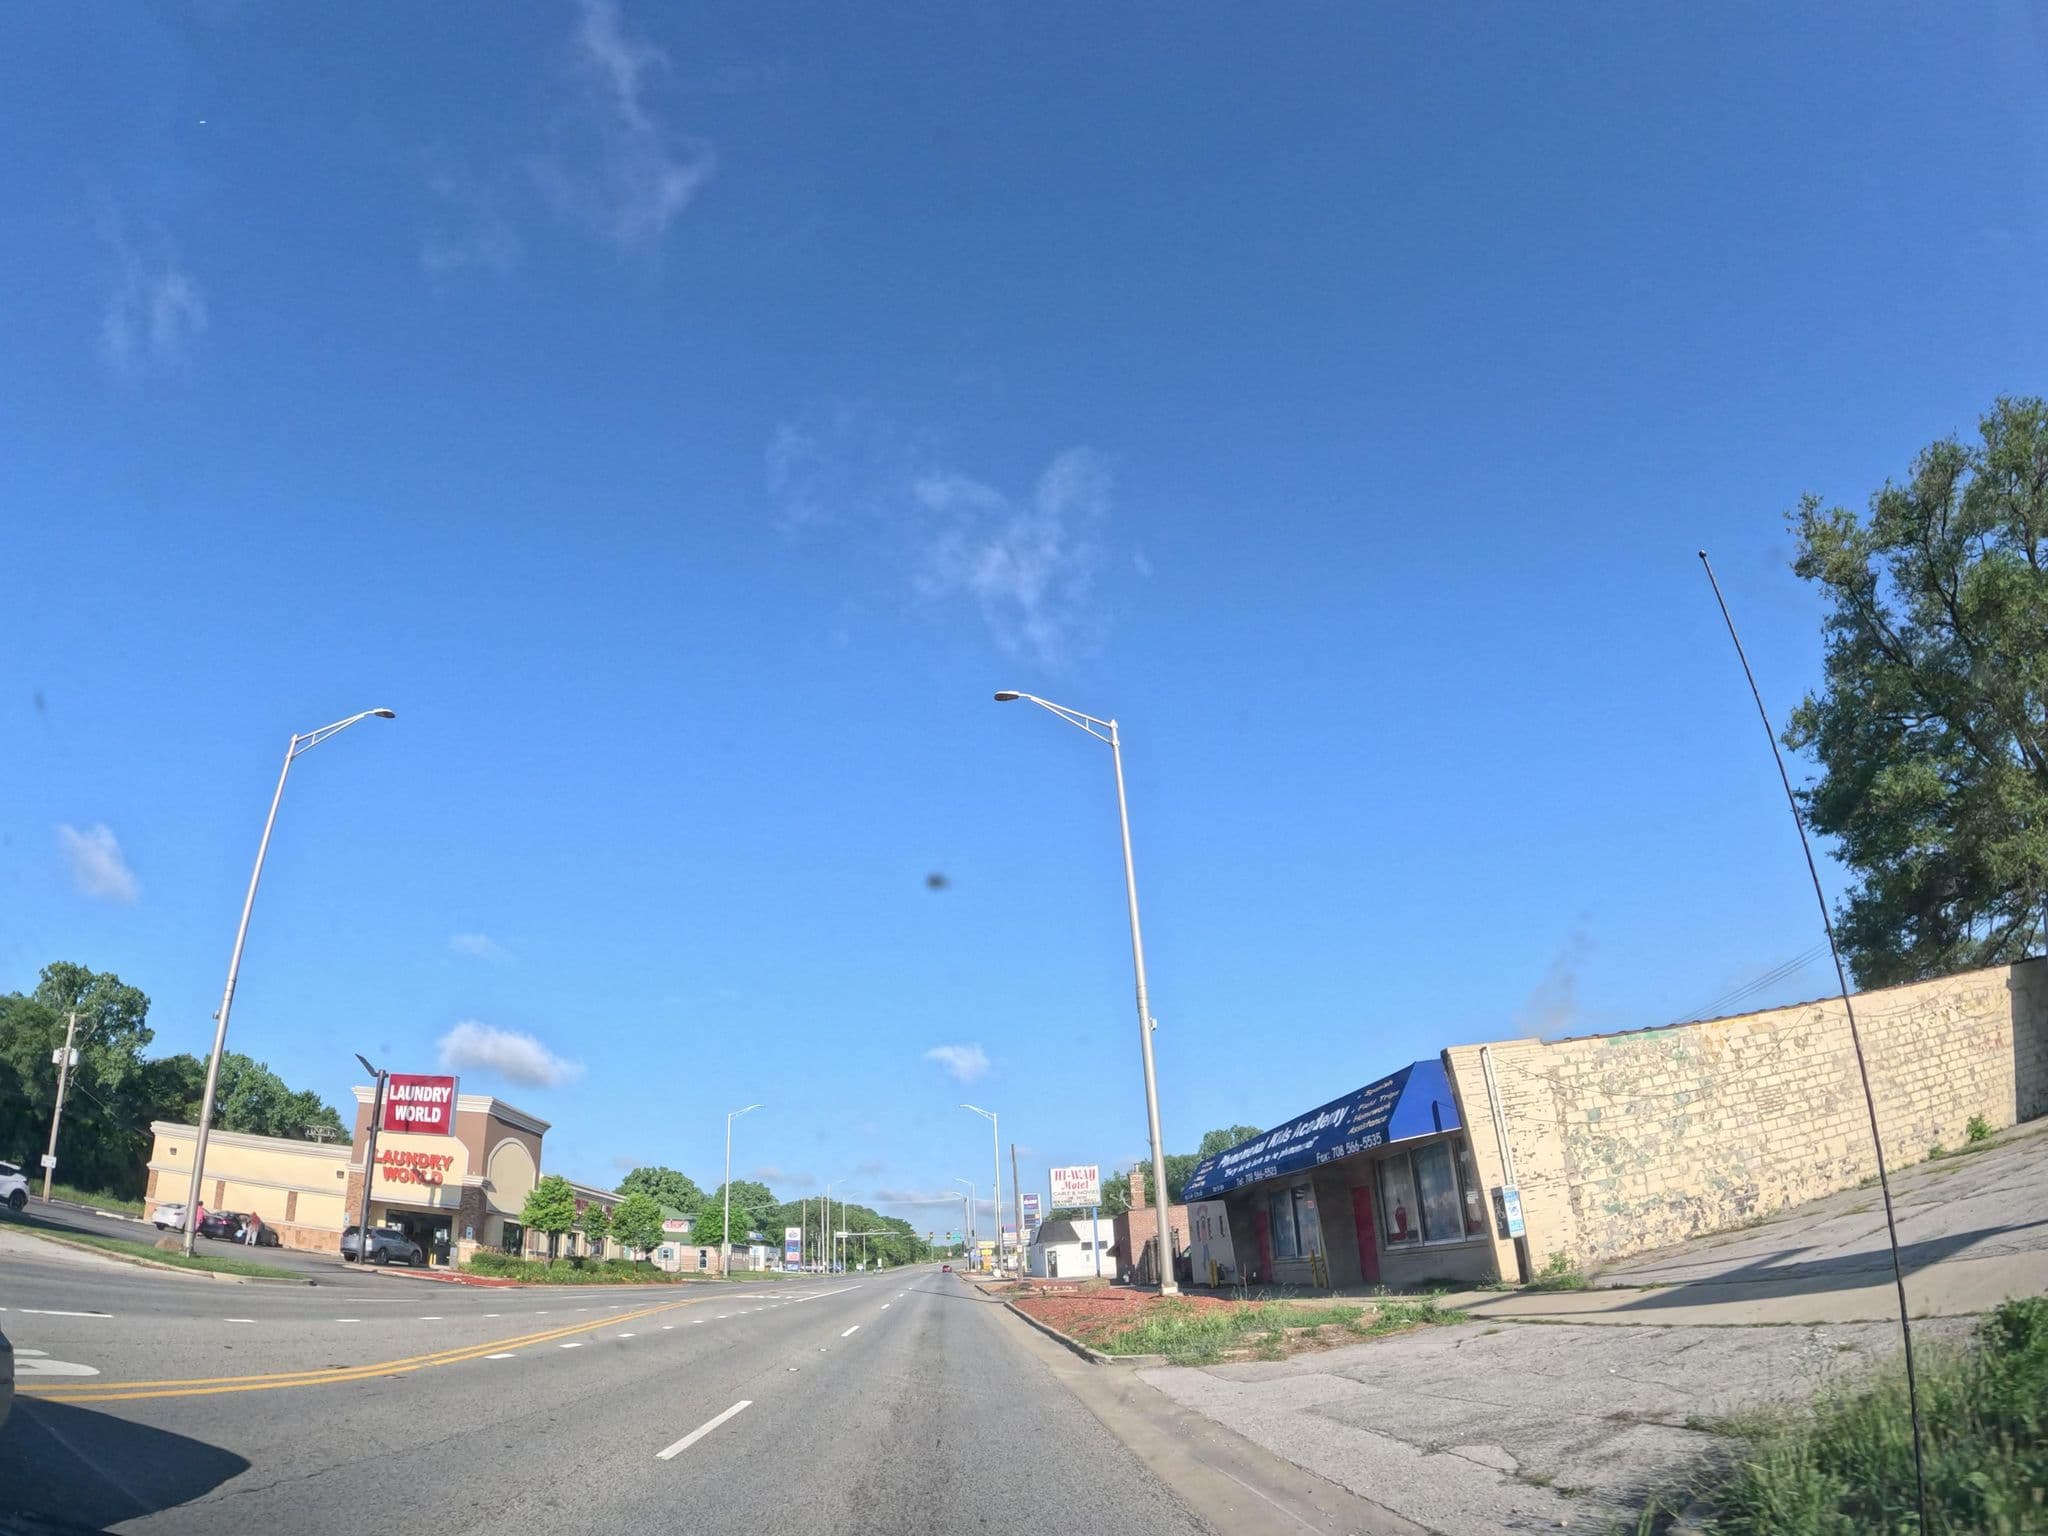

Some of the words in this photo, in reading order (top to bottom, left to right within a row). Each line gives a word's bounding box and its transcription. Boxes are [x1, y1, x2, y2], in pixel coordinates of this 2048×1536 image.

[389, 1085, 451, 1103] LAUNDRY
[395, 1105, 441, 1123] WORLD
[1290, 1106, 1350, 1140] Academy
[375, 1149, 454, 1171] LAUNDRY
[383, 1166, 443, 1185] WORLD
